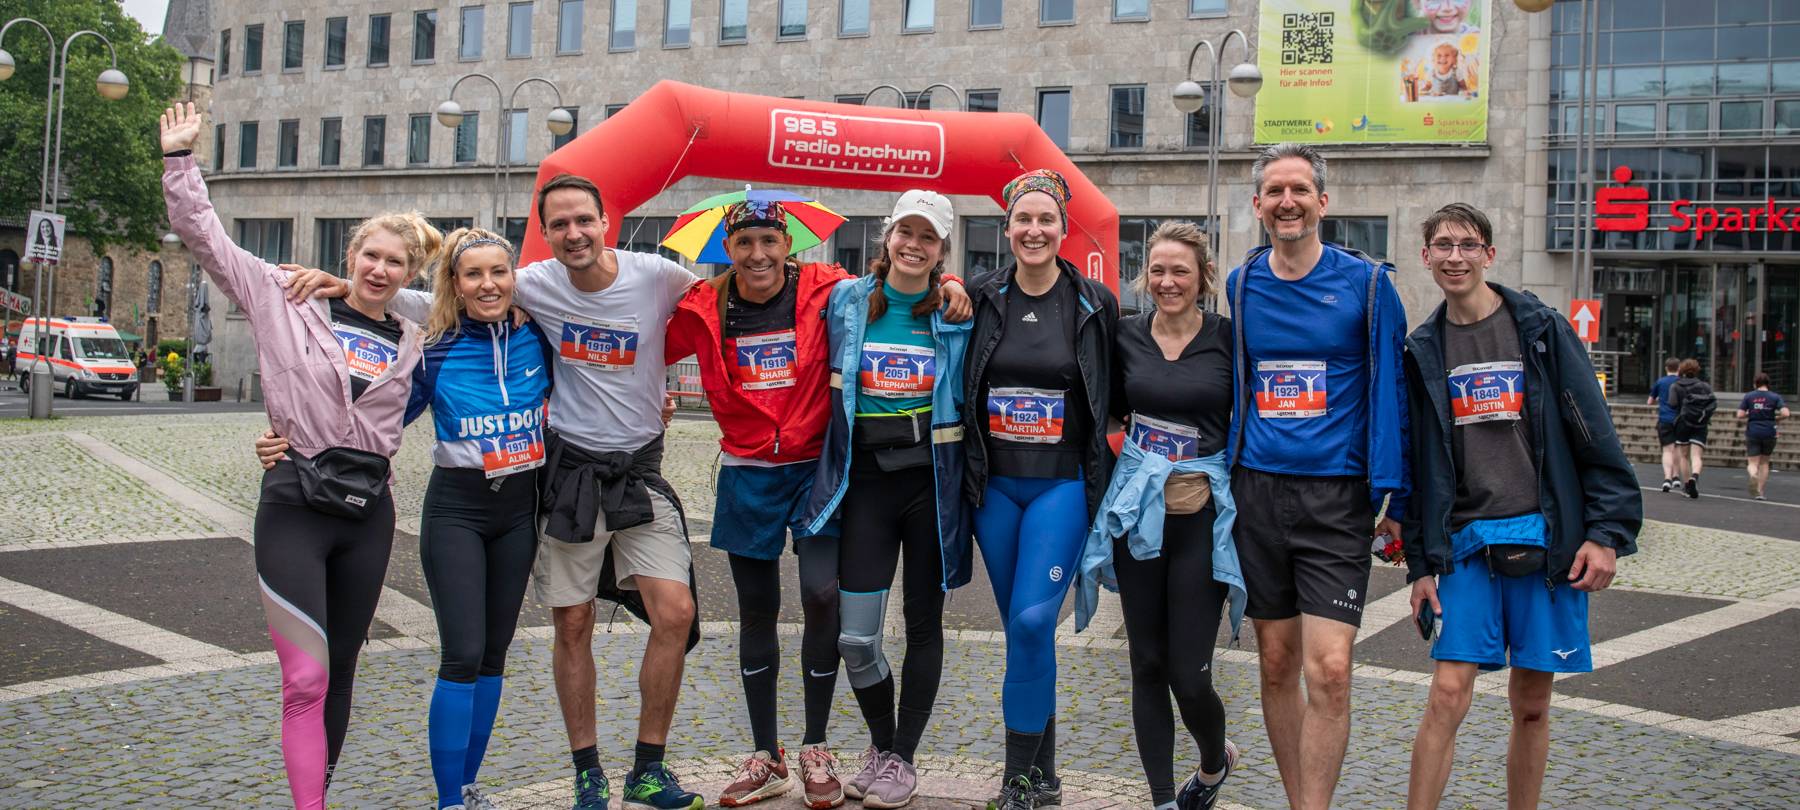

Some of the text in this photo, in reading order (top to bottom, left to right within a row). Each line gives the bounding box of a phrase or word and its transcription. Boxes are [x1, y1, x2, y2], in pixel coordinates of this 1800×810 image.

[1280, 68, 1296, 76] Hier
[1280, 80, 1291, 88] für
[1310, 79, 1333, 87] Infos!
[783, 116, 837, 137] 98.5
[1263, 119, 1312, 128] STADTWERKE
[784, 138, 931, 162] radio bochum
[587, 341, 611, 352] 1919
[357, 350, 379, 363] 1920
[588, 353, 608, 362] NILS
[350, 359, 382, 374] ANNIKA
[762, 358, 786, 369] 1918
[760, 370, 791, 380] SHARIF
[885, 368, 909, 379] 2051
[875, 380, 918, 390] STEPHANIE
[1275, 387, 1299, 397] 1923
[1474, 389, 1499, 400] 1848
[1278, 400, 1296, 408] JAN
[1472, 401, 1505, 413] JUSTIN
[1013, 412, 1038, 423] 1924
[459, 414, 506, 438] JUST
[509, 409, 533, 432] DO
[1005, 424, 1046, 434] MARTINA
[507, 440, 529, 453] 1917
[508, 453, 531, 464] ALINA
